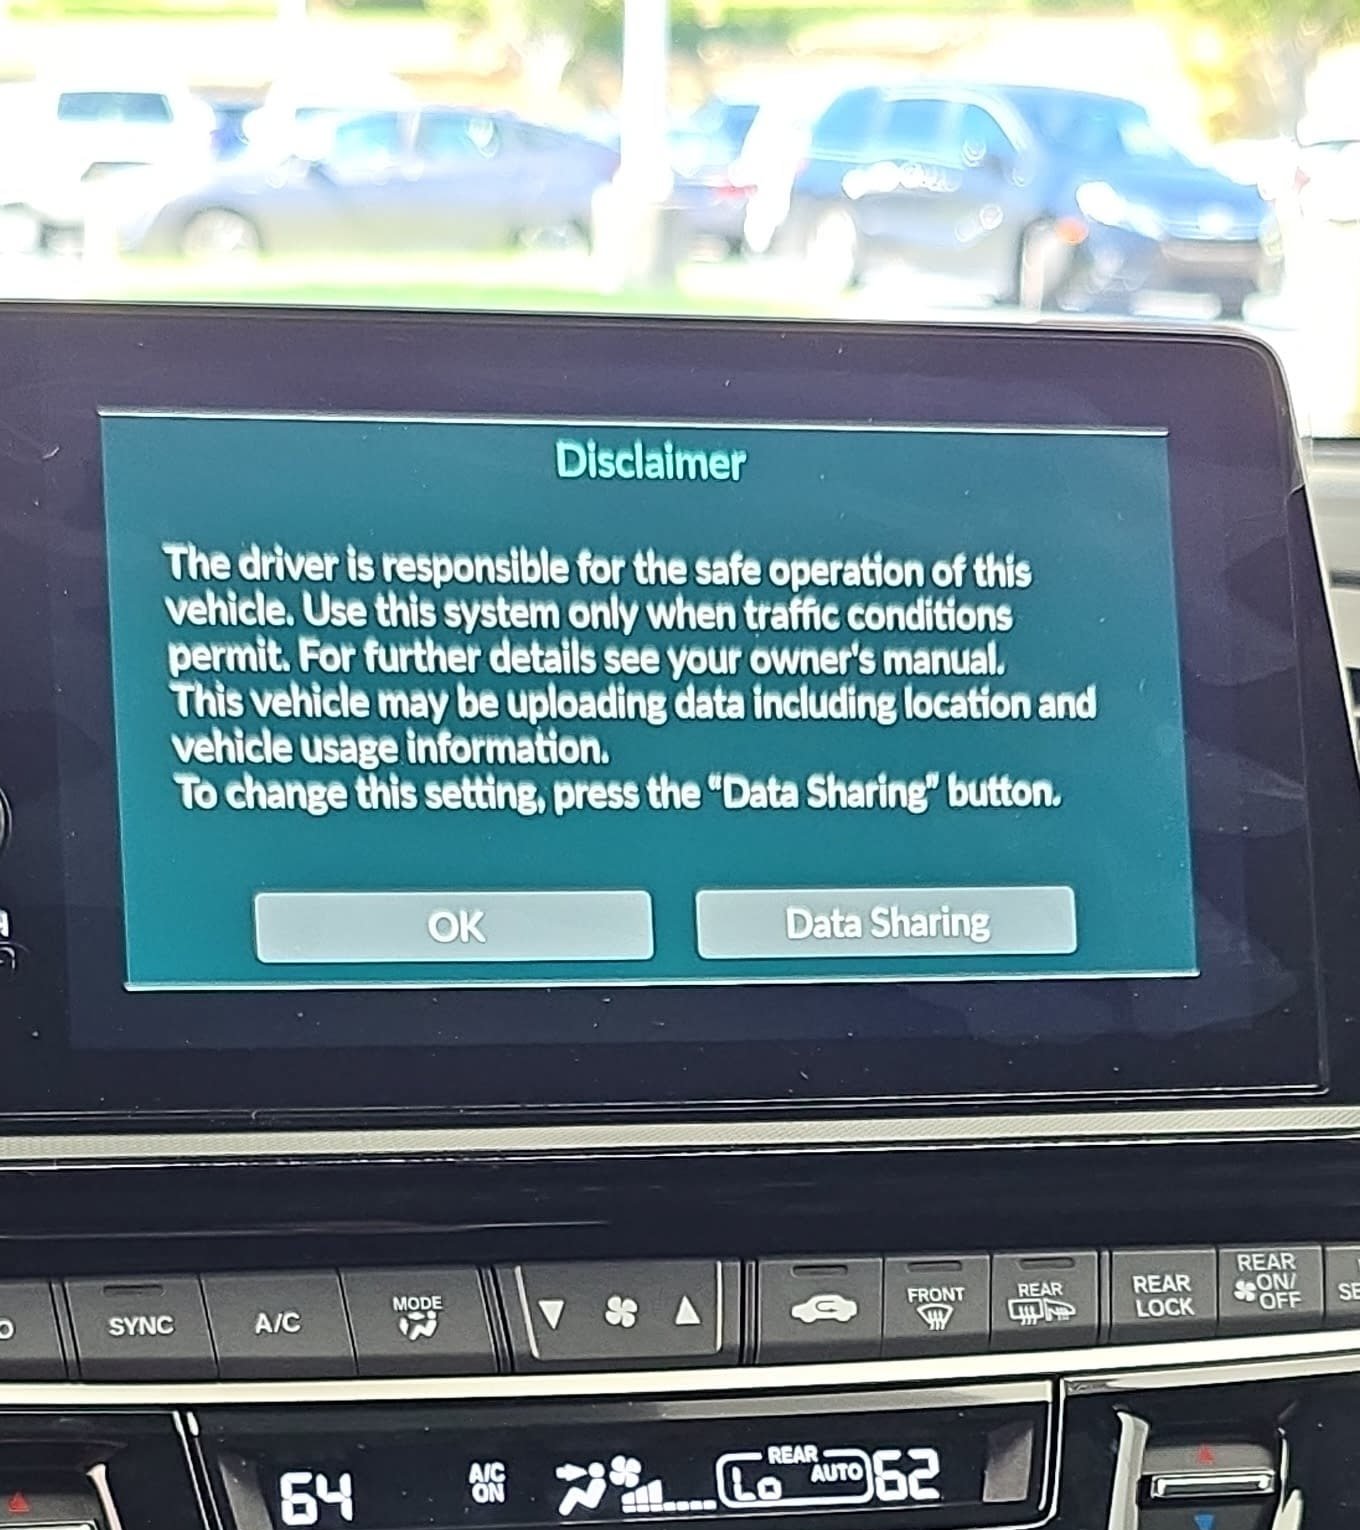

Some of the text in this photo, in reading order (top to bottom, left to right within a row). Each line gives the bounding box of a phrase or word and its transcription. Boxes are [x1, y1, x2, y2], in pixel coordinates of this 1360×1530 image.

[555, 439, 747, 482] Disclaimer
[161, 543, 1033, 592] The driver is responsible for the safe operation of this
[164, 589, 1014, 636] vehicle. Use this system only when traffic conditions
[168, 635, 1005, 681] permit. For further details see your owner's manual.
[169, 680, 1097, 725] This vehicle may be uploading data including location and
[171, 727, 610, 770] vehicle usage information.
[173, 772, 218, 810] To
[224, 772, 348, 815] change
[355, 772, 419, 810] this
[424, 772, 546, 815] setting,
[553, 779, 640, 816] press
[647, 771, 702, 810] the
[947, 771, 1062, 808] button.
[427, 909, 487, 943] OK
[785, 904, 991, 943] Data Sharing
[1237, 1252, 1296, 1272] REAR
[1017, 1282, 1063, 1298] REAR
[1133, 1274, 1192, 1293] REAR
[1256, 1273, 1296, 1291] ON/
[392, 1296, 443, 1311] MODE
[907, 1287, 965, 1303] FRONT
[1259, 1291, 1302, 1310] OFF
[1136, 1298, 1195, 1318] LOCK
[108, 1316, 175, 1337] SYNC
[255, 1312, 301, 1334] A/C
[767, 1445, 819, 1465] REAR
[469, 1461, 506, 1484] A/C
[811, 1463, 863, 1483] AUTO
[872, 1448, 940, 1501] 62
[280, 1471, 353, 1526] 64
[472, 1482, 505, 1504] ON
